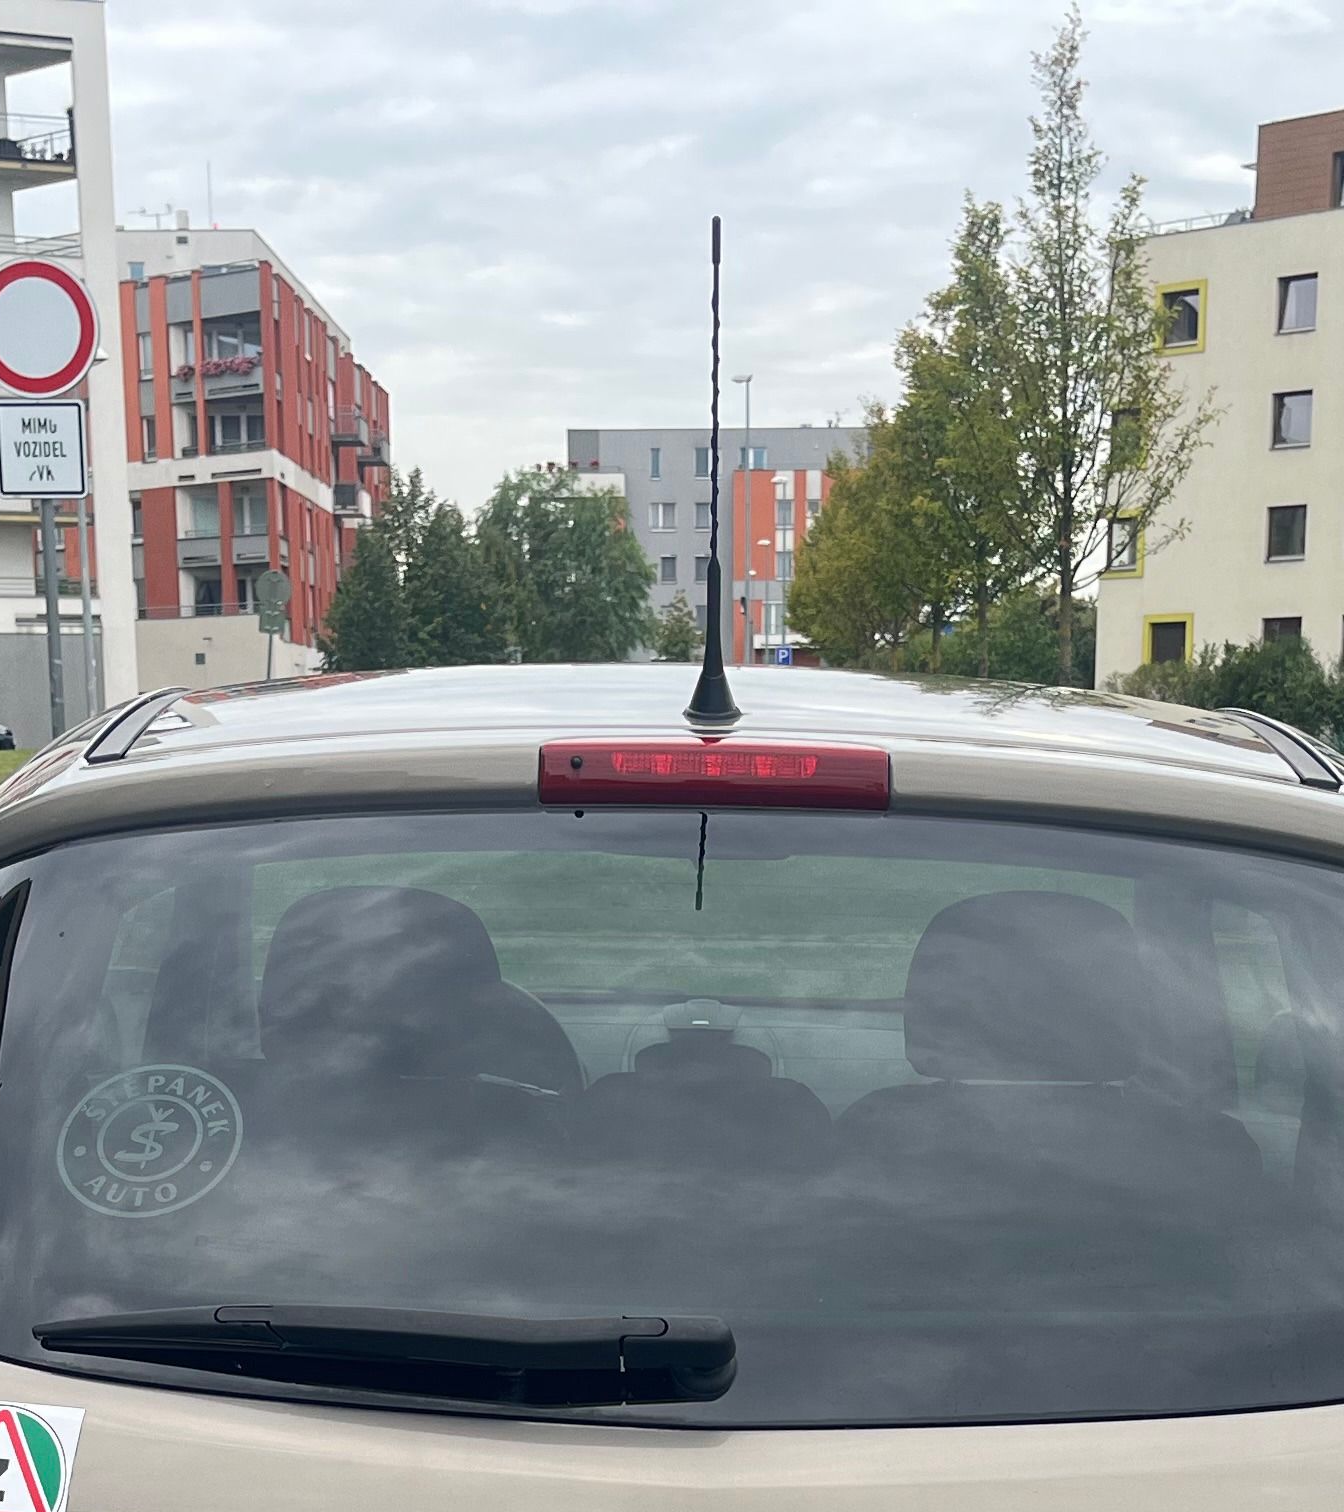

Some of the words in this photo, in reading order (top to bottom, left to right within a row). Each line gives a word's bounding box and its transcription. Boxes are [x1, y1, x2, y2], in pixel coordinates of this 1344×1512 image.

[14, 441, 67, 457] VOZIDEL
[29, 465, 55, 481] VK
[778, 649, 789, 663] P
[83, 1175, 178, 1207] AUTO
